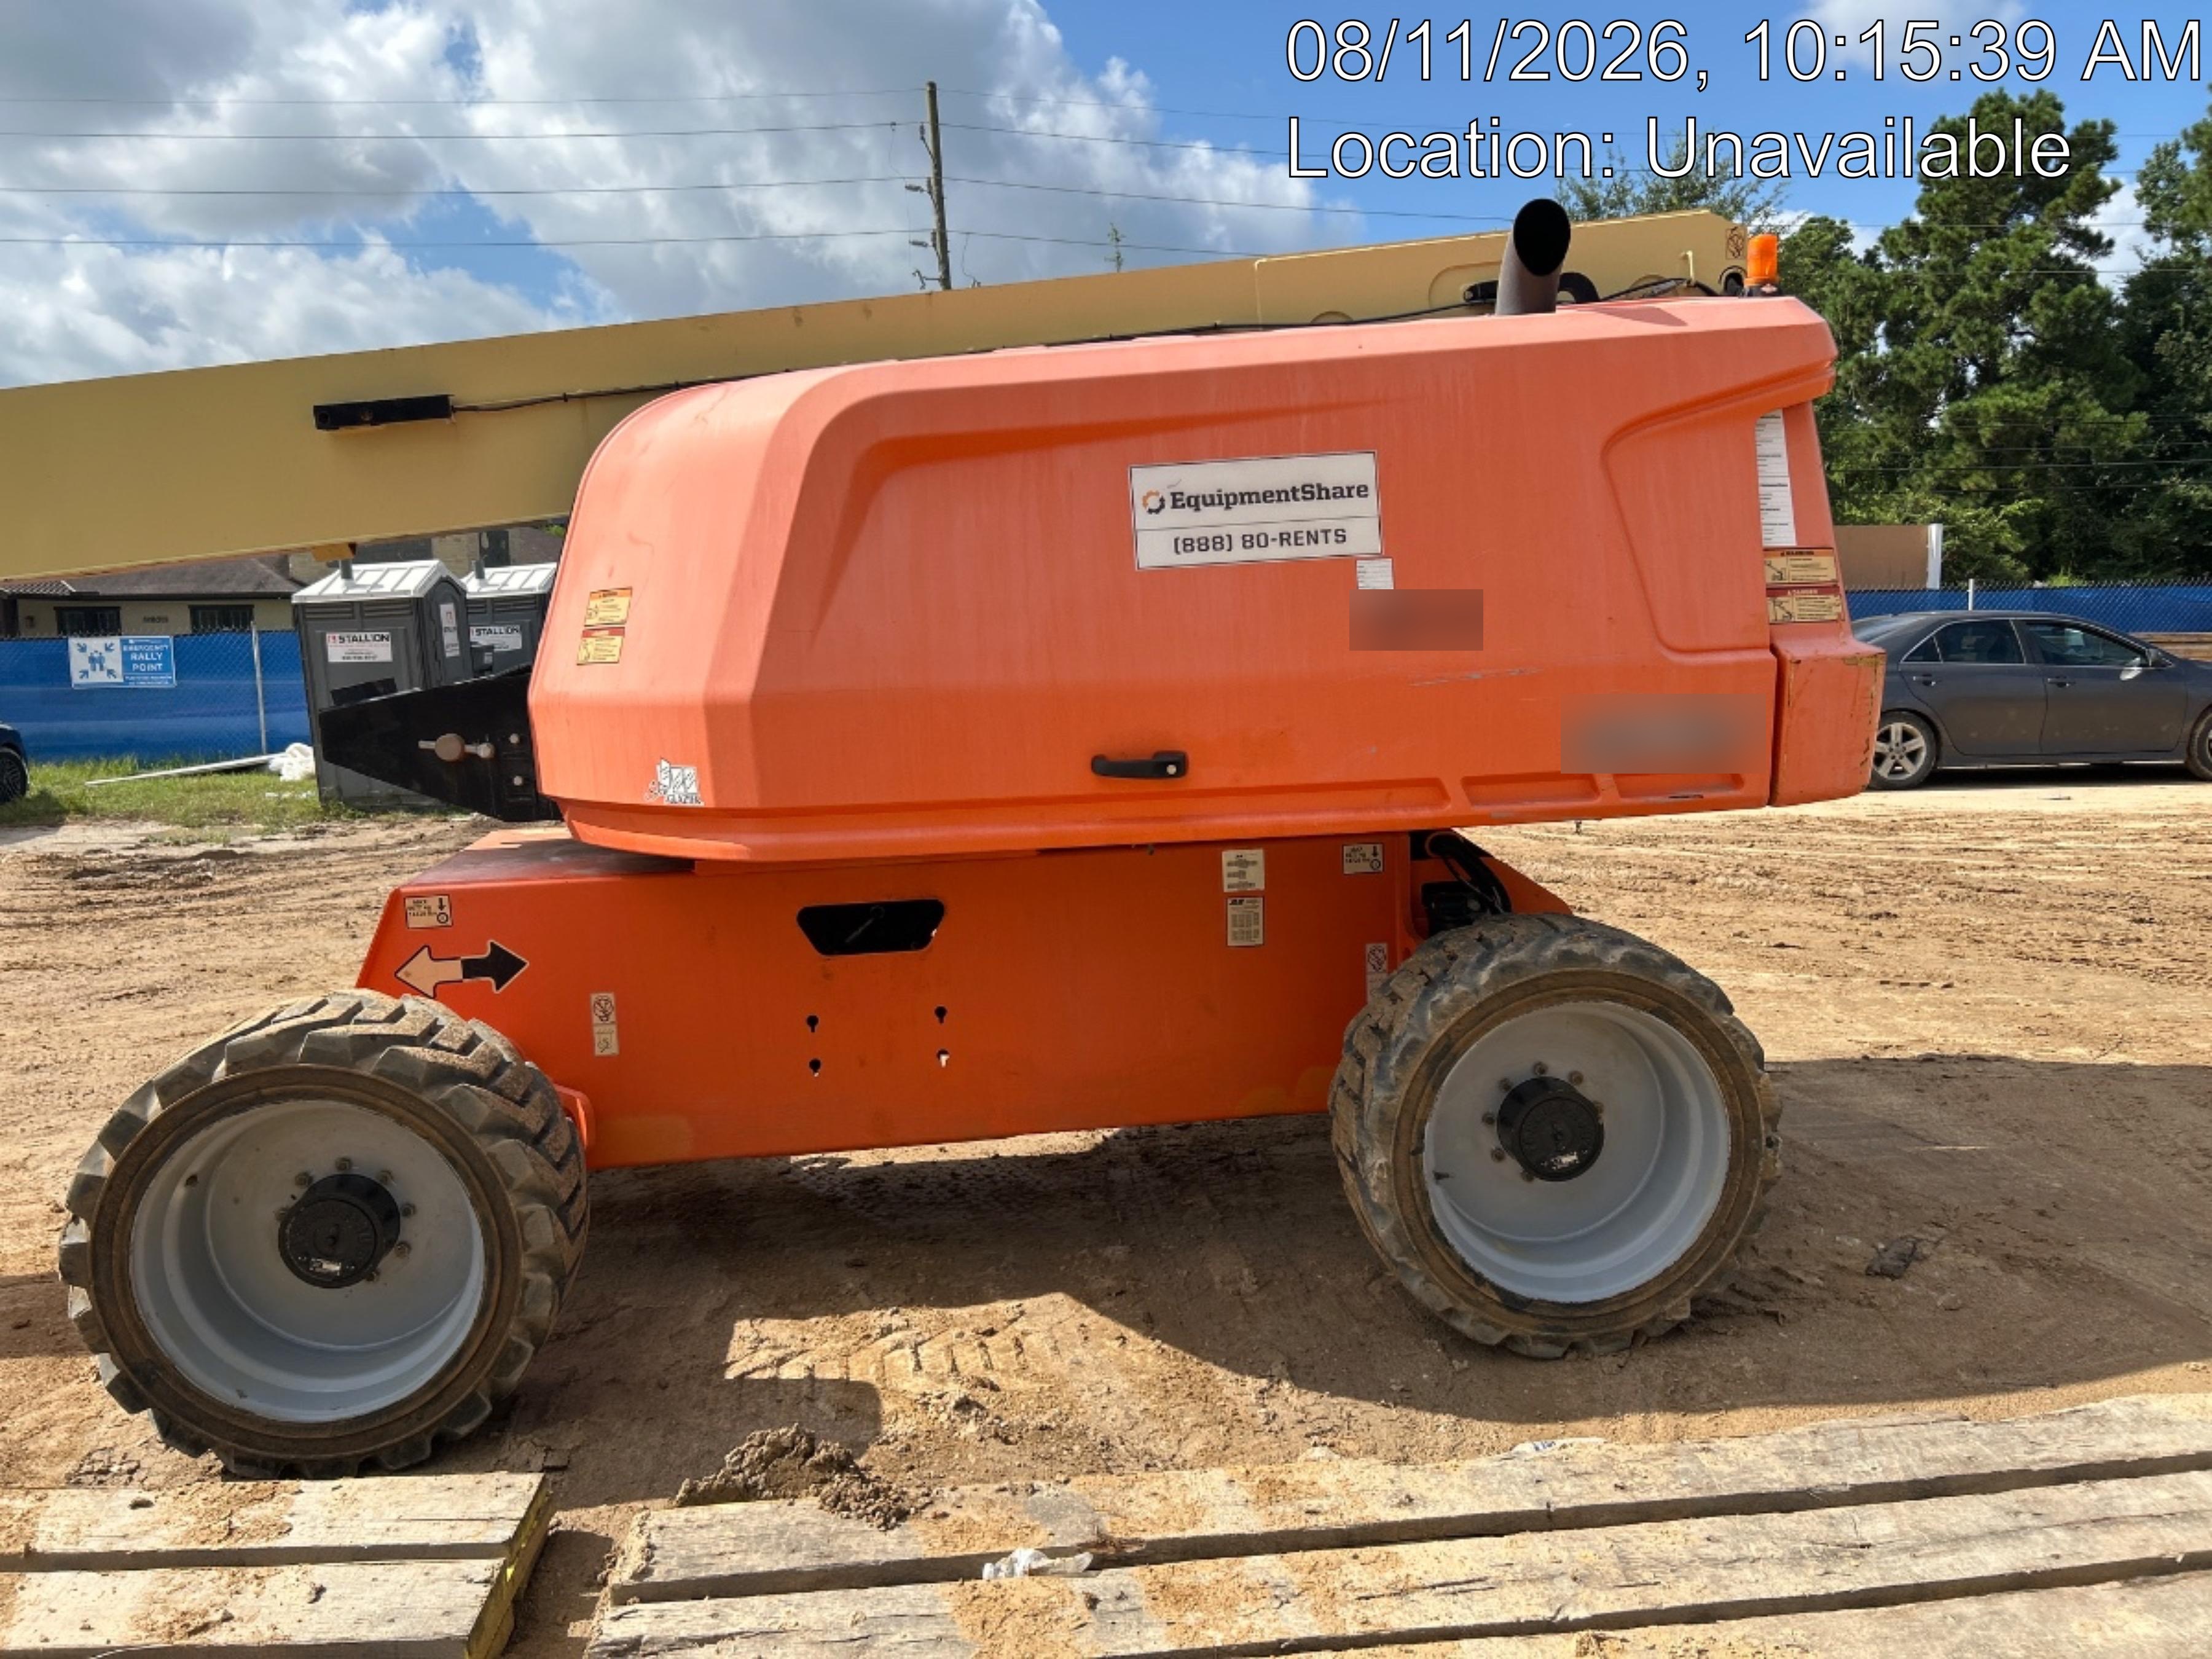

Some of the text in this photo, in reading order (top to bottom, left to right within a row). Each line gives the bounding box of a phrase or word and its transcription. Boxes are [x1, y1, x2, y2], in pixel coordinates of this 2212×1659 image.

[1170, 482, 1369, 512] EquipmentShare
[1174, 528, 1347, 555] (888) 80-RENTS
[130, 652, 163, 661] RALLY
[132, 663, 163, 672] POINT
